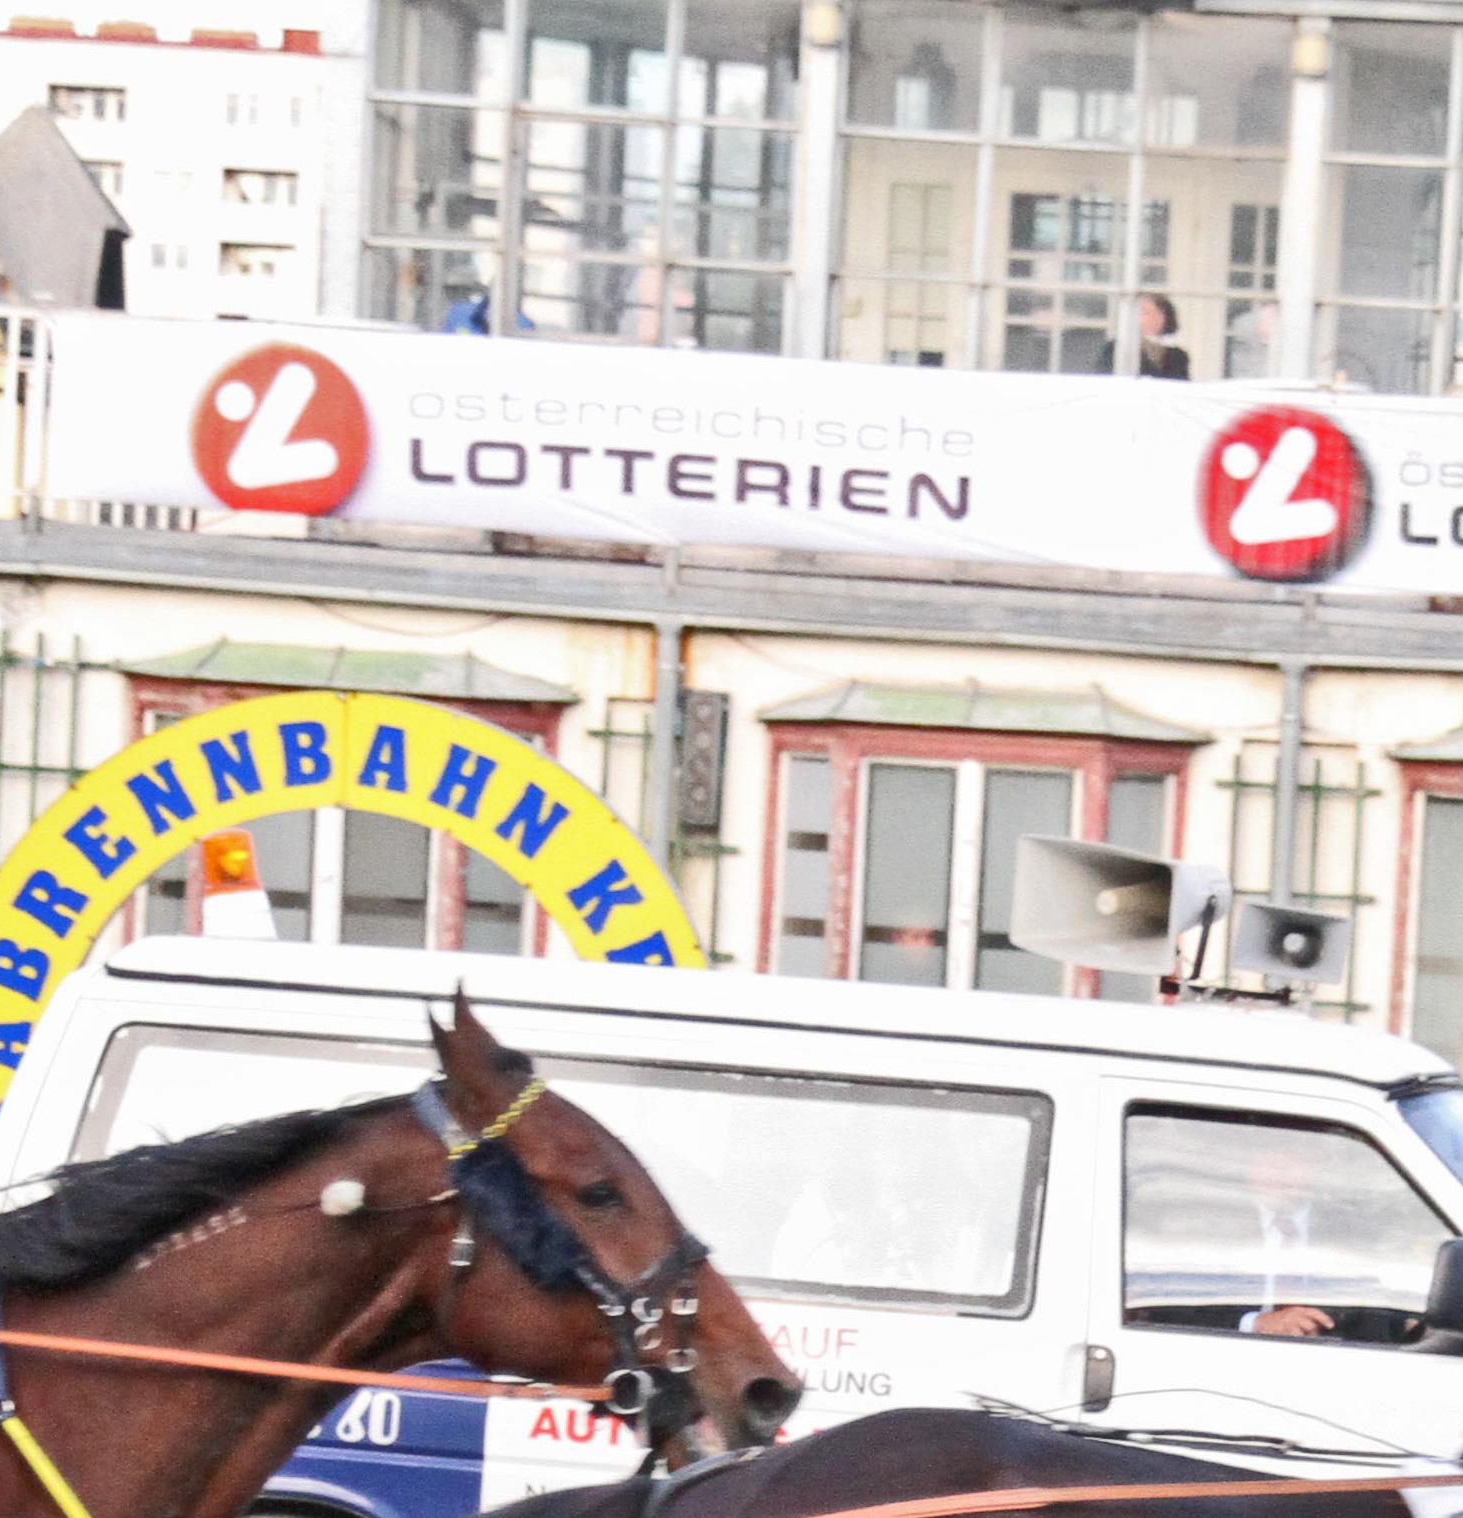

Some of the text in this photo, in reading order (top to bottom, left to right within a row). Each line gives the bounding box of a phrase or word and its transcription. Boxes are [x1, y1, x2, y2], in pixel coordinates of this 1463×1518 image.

[410, 437, 972, 522] LOTTERIEN
[757, 1324, 861, 1361] AUF
[794, 1368, 893, 1398] LUNG
[529, 1406, 630, 1447] AUT
